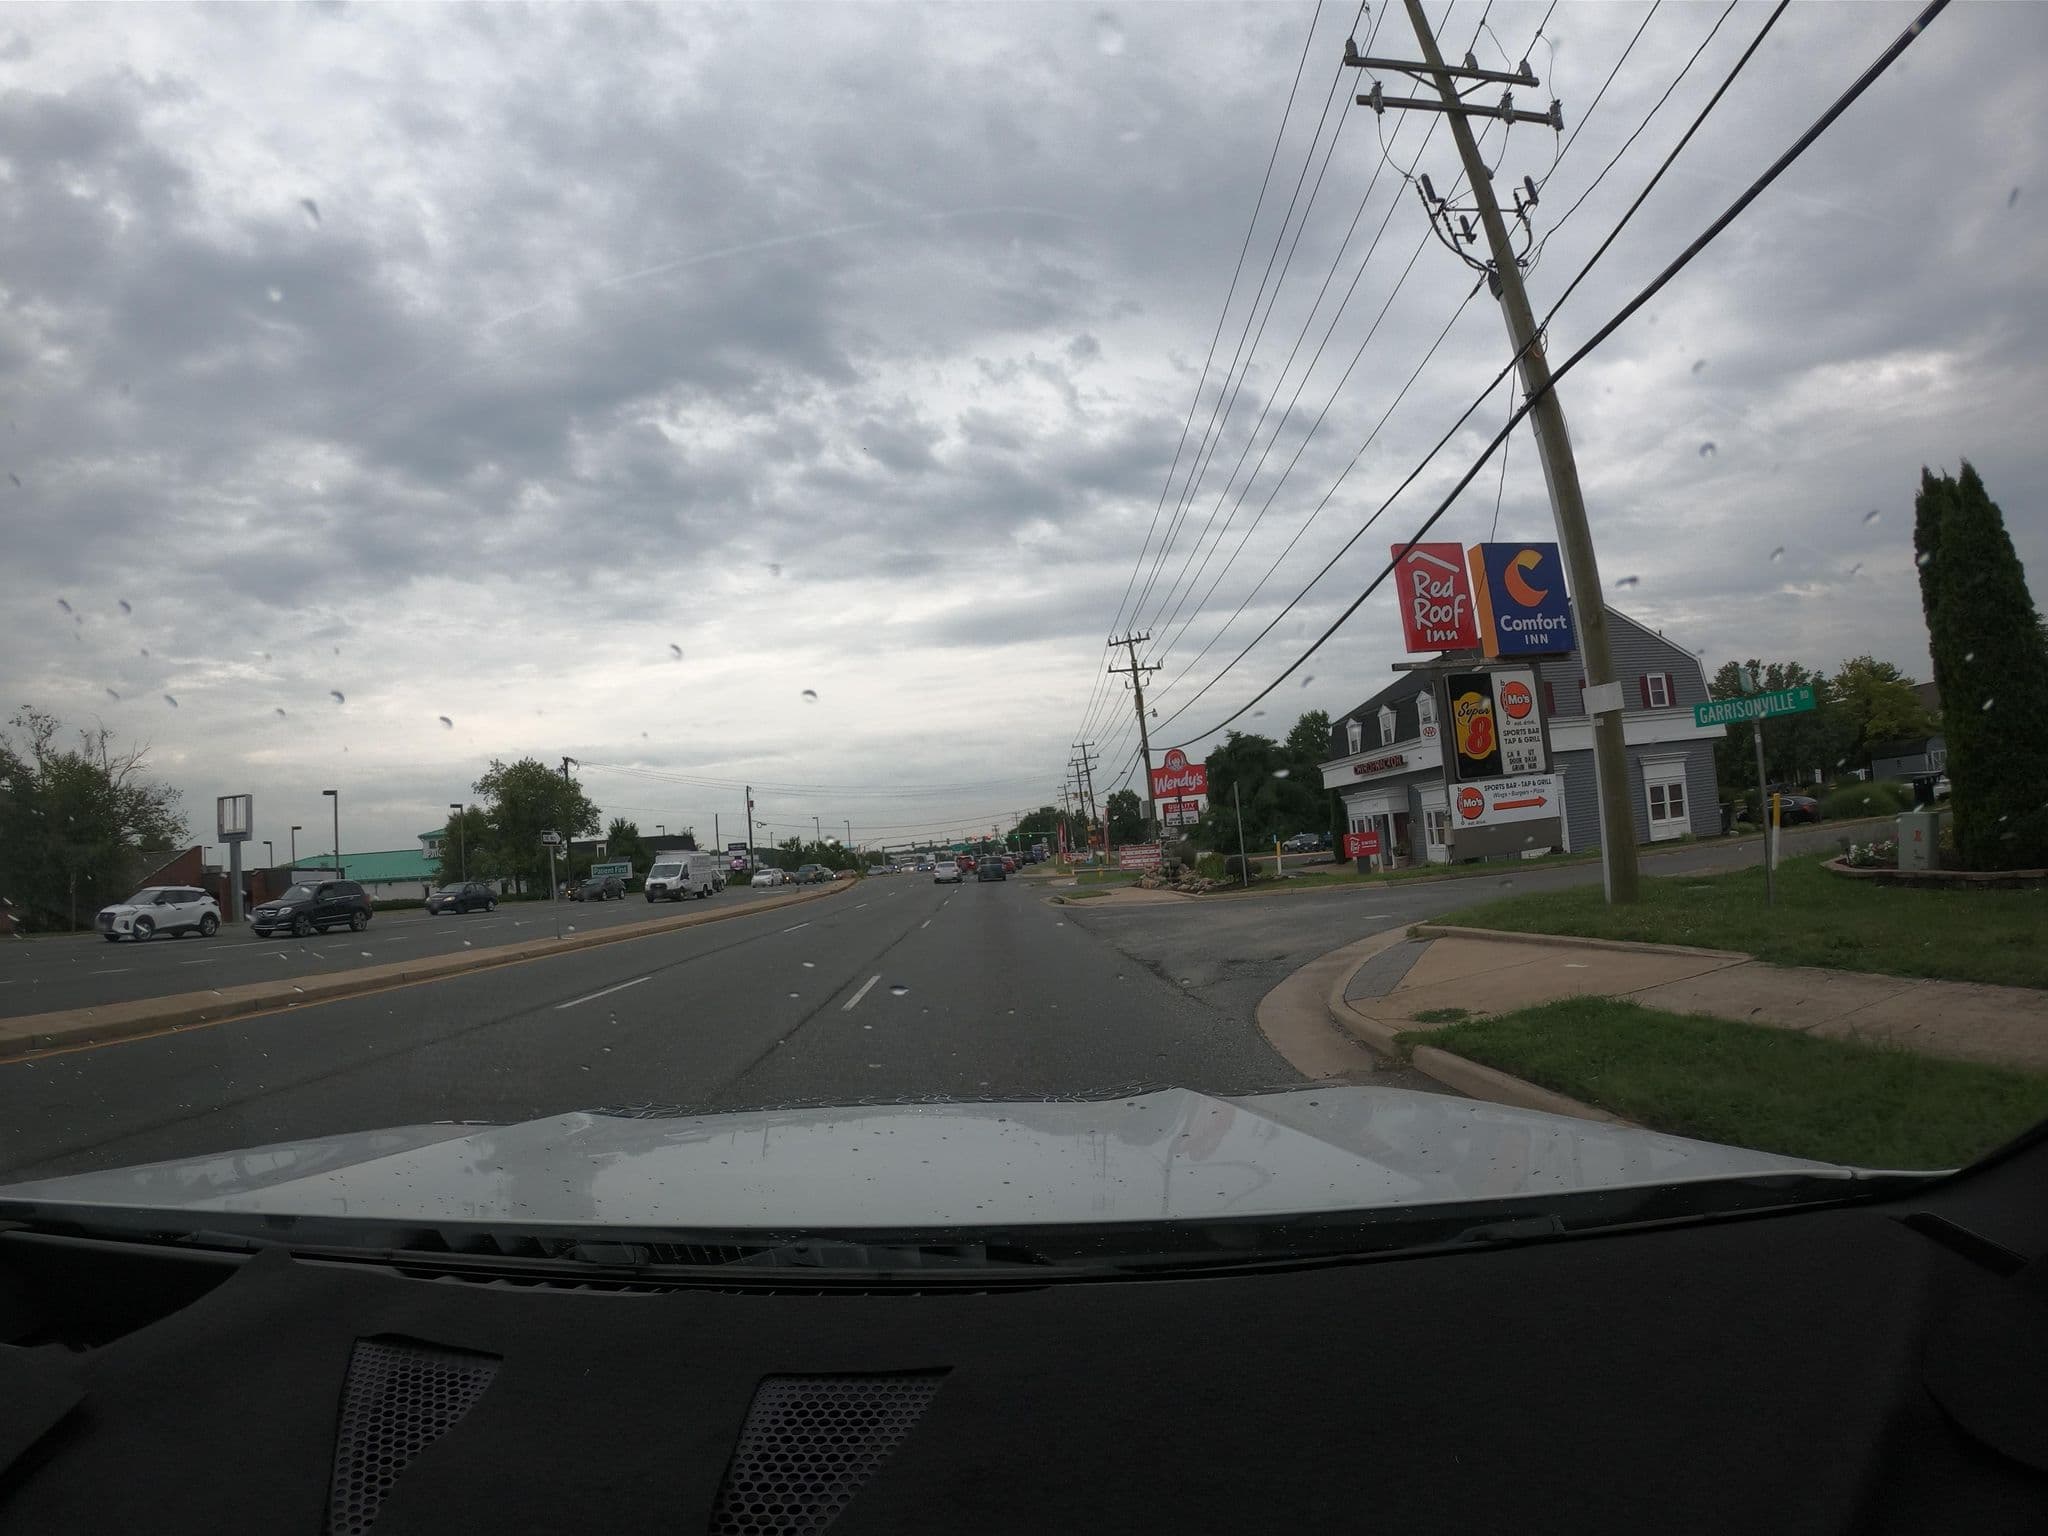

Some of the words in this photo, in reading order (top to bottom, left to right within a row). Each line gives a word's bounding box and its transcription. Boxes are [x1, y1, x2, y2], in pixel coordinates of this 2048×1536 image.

[1413, 570, 1454, 599] Red
[1414, 594, 1466, 630] Roof
[1500, 613, 1567, 631] Comfort
[1524, 633, 1549, 645] INN
[1508, 694, 1530, 705] Mo's
[1699, 692, 1797, 724] GARRISONVILLE
[1799, 689, 1809, 700] RD
[1466, 716, 1492, 754] 8
[1503, 728, 1527, 737] SPORTS
[1528, 727, 1540, 735] BAR
[1504, 737, 1517, 745] TAP
[1524, 736, 1541, 744] GRILL
[1154, 770, 1203, 795] Wendy's
[1484, 784, 1505, 792] SPORTS
[1505, 782, 1517, 790] BAR
[1521, 780, 1532, 788] TAP
[1537, 778, 1552, 786] GRILL
[1463, 797, 1483, 808] Mo's
[593, 866, 614, 875] Patient
[614, 865, 627, 873] First
